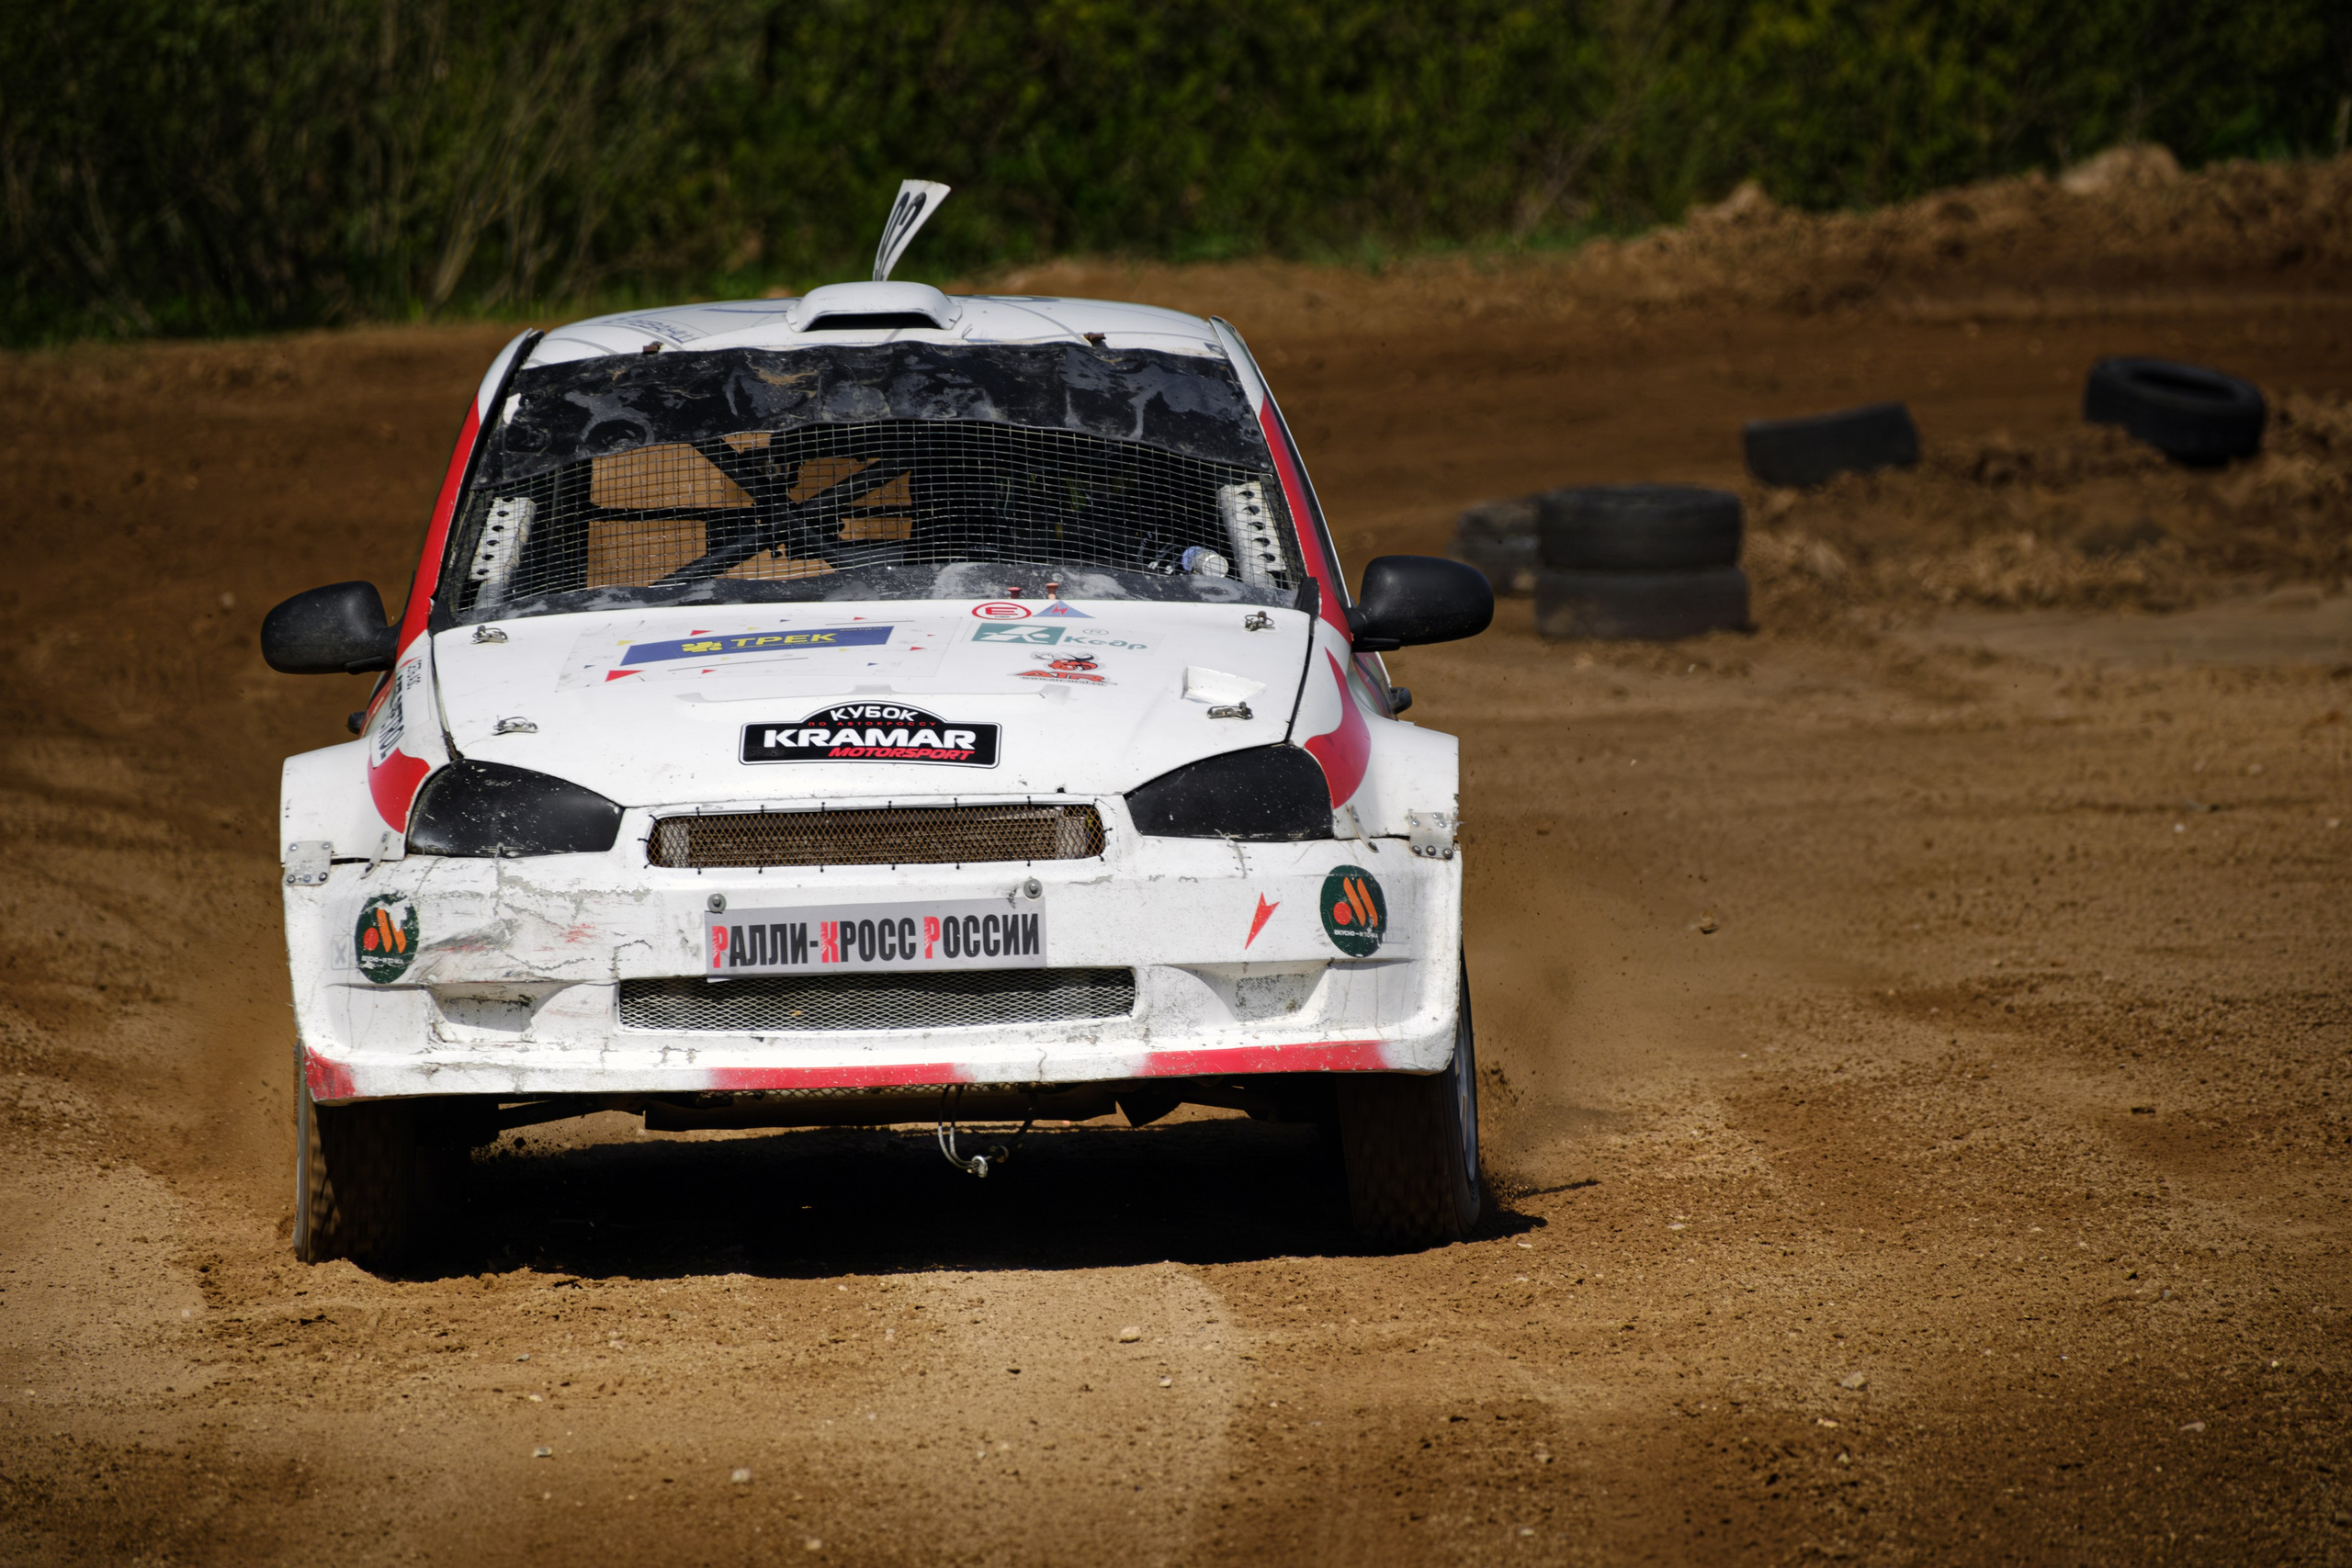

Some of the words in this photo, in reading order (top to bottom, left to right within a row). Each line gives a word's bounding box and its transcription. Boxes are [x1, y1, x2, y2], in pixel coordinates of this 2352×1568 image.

[730, 633, 837, 647] ТРЕК
[830, 705, 919, 721] КУБОК
[763, 728, 977, 750] KRAMAR
[828, 746, 976, 761] MOTORSPORT
[711, 917, 917, 969] РАЛЛИ-КРОСС
[923, 913, 1039, 960] РОССИИ
